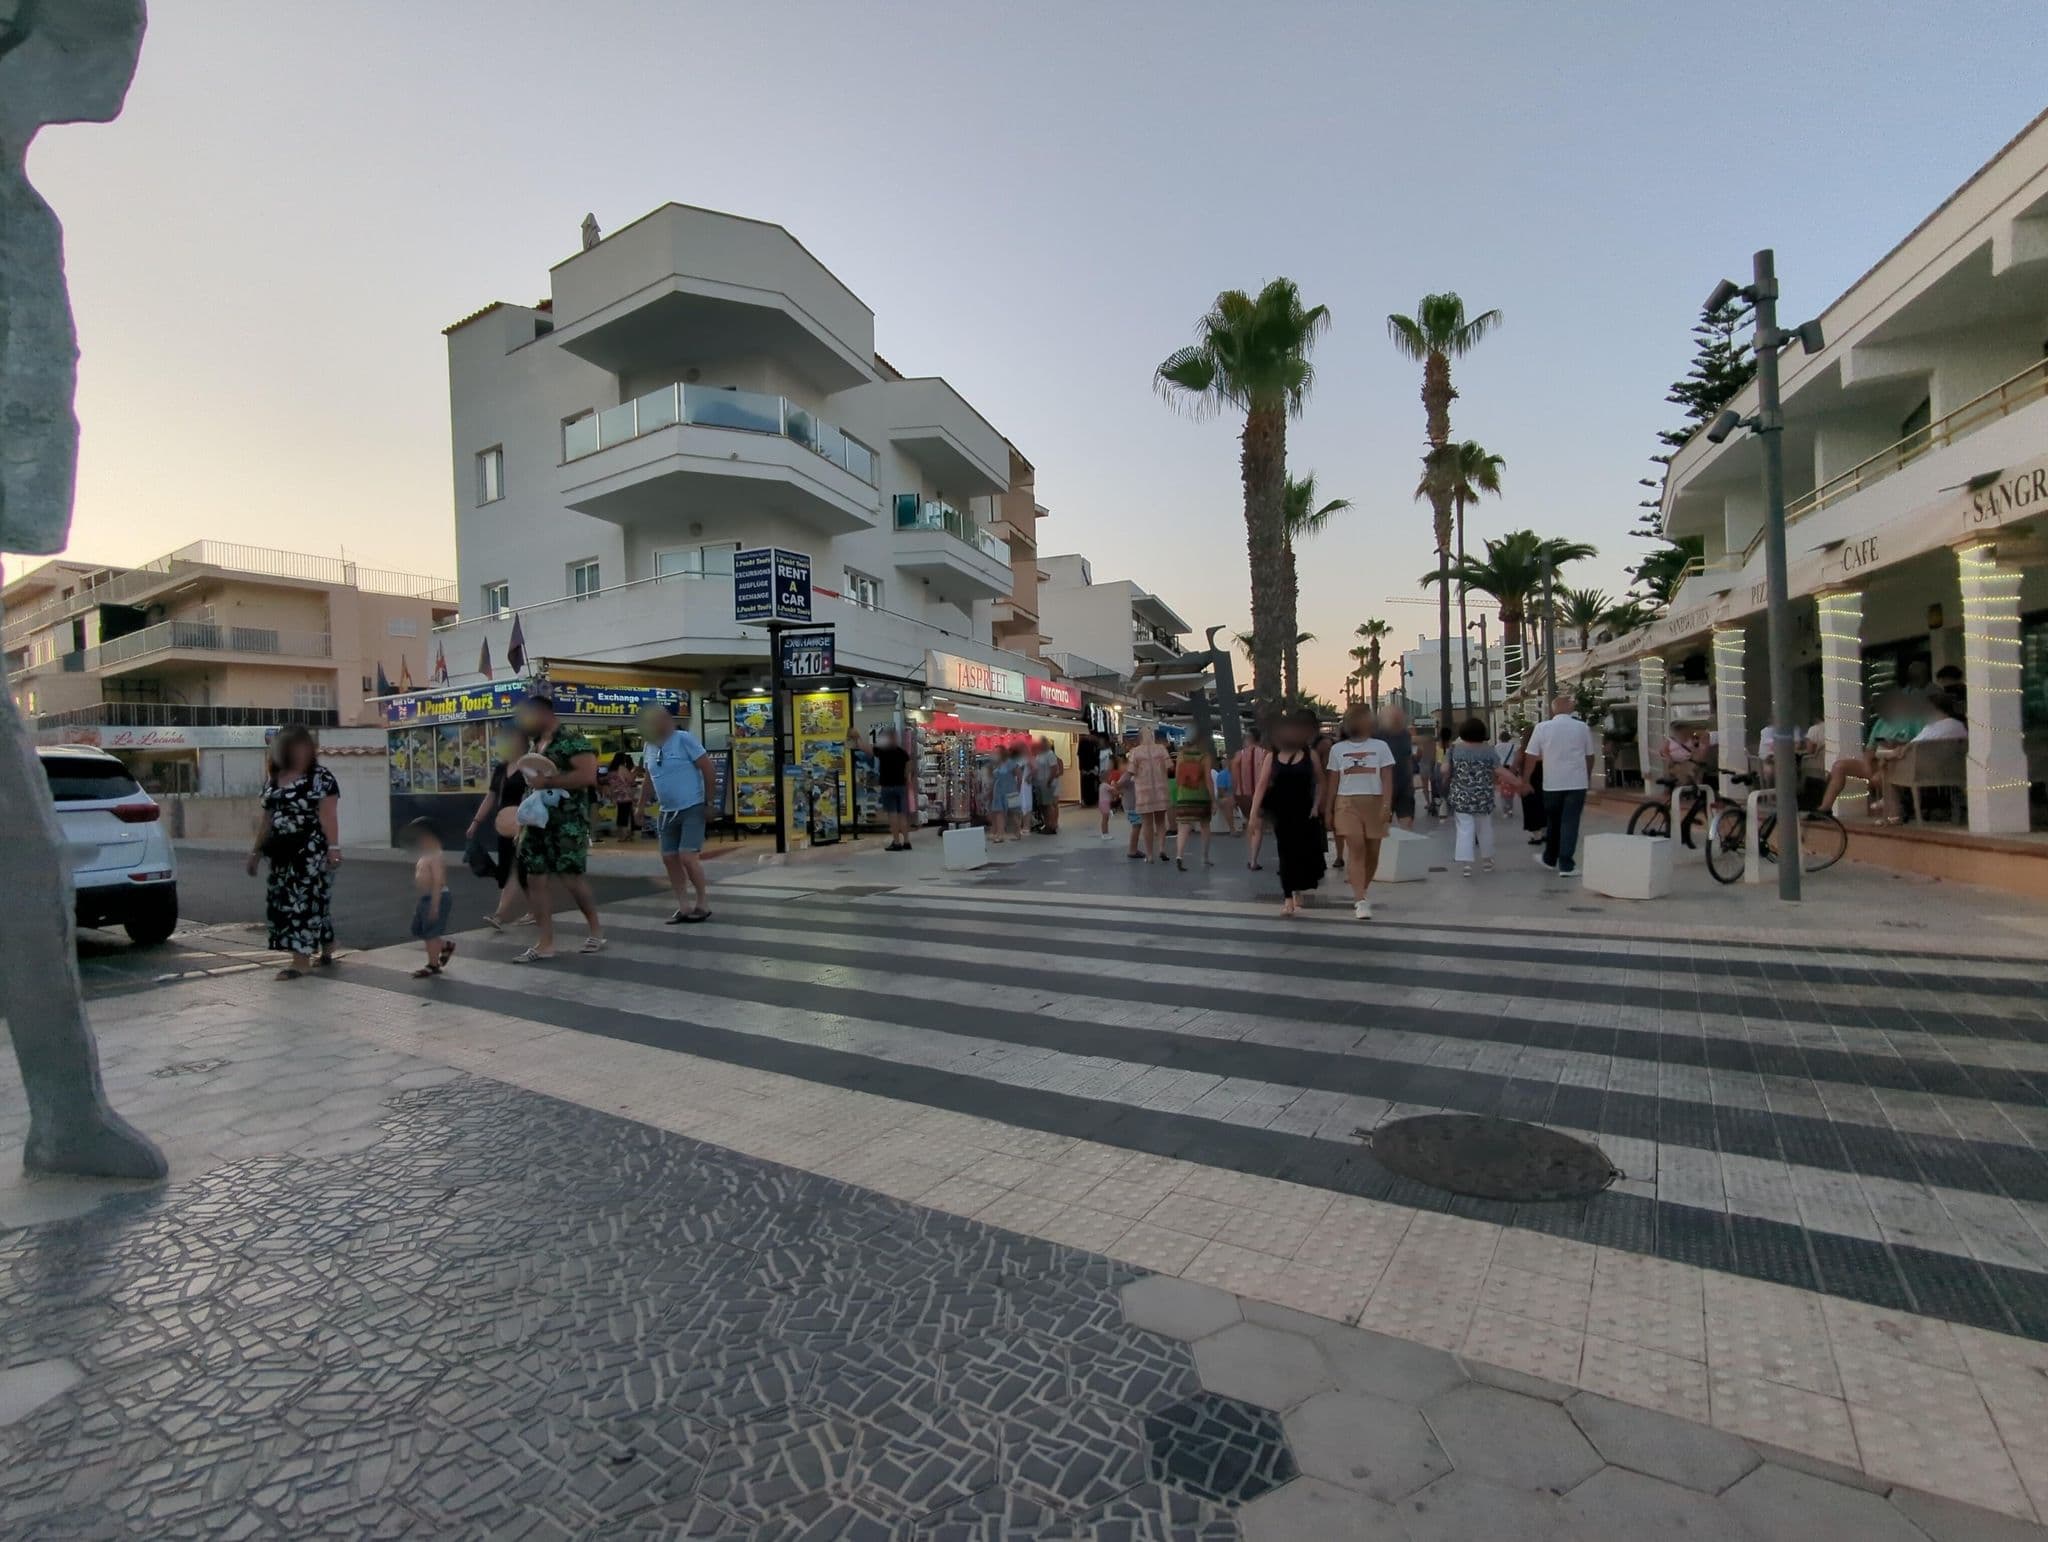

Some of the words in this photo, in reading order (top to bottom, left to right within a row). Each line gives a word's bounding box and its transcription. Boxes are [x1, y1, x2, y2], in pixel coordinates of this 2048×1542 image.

[1843, 536, 1880, 571] CAFE
[735, 568, 771, 578] EXCURSIONS
[778, 565, 808, 581] RENT
[789, 581, 798, 593] A
[738, 592, 769, 601] EXCHANGE
[781, 593, 805, 607] CAR
[784, 637, 830, 648] EXCHANGE
[957, 663, 1008, 694] JASPREET
[460, 692, 494, 712] Tours
[598, 693, 640, 703] Exchange
[439, 712, 467, 721] EXCHANGE
